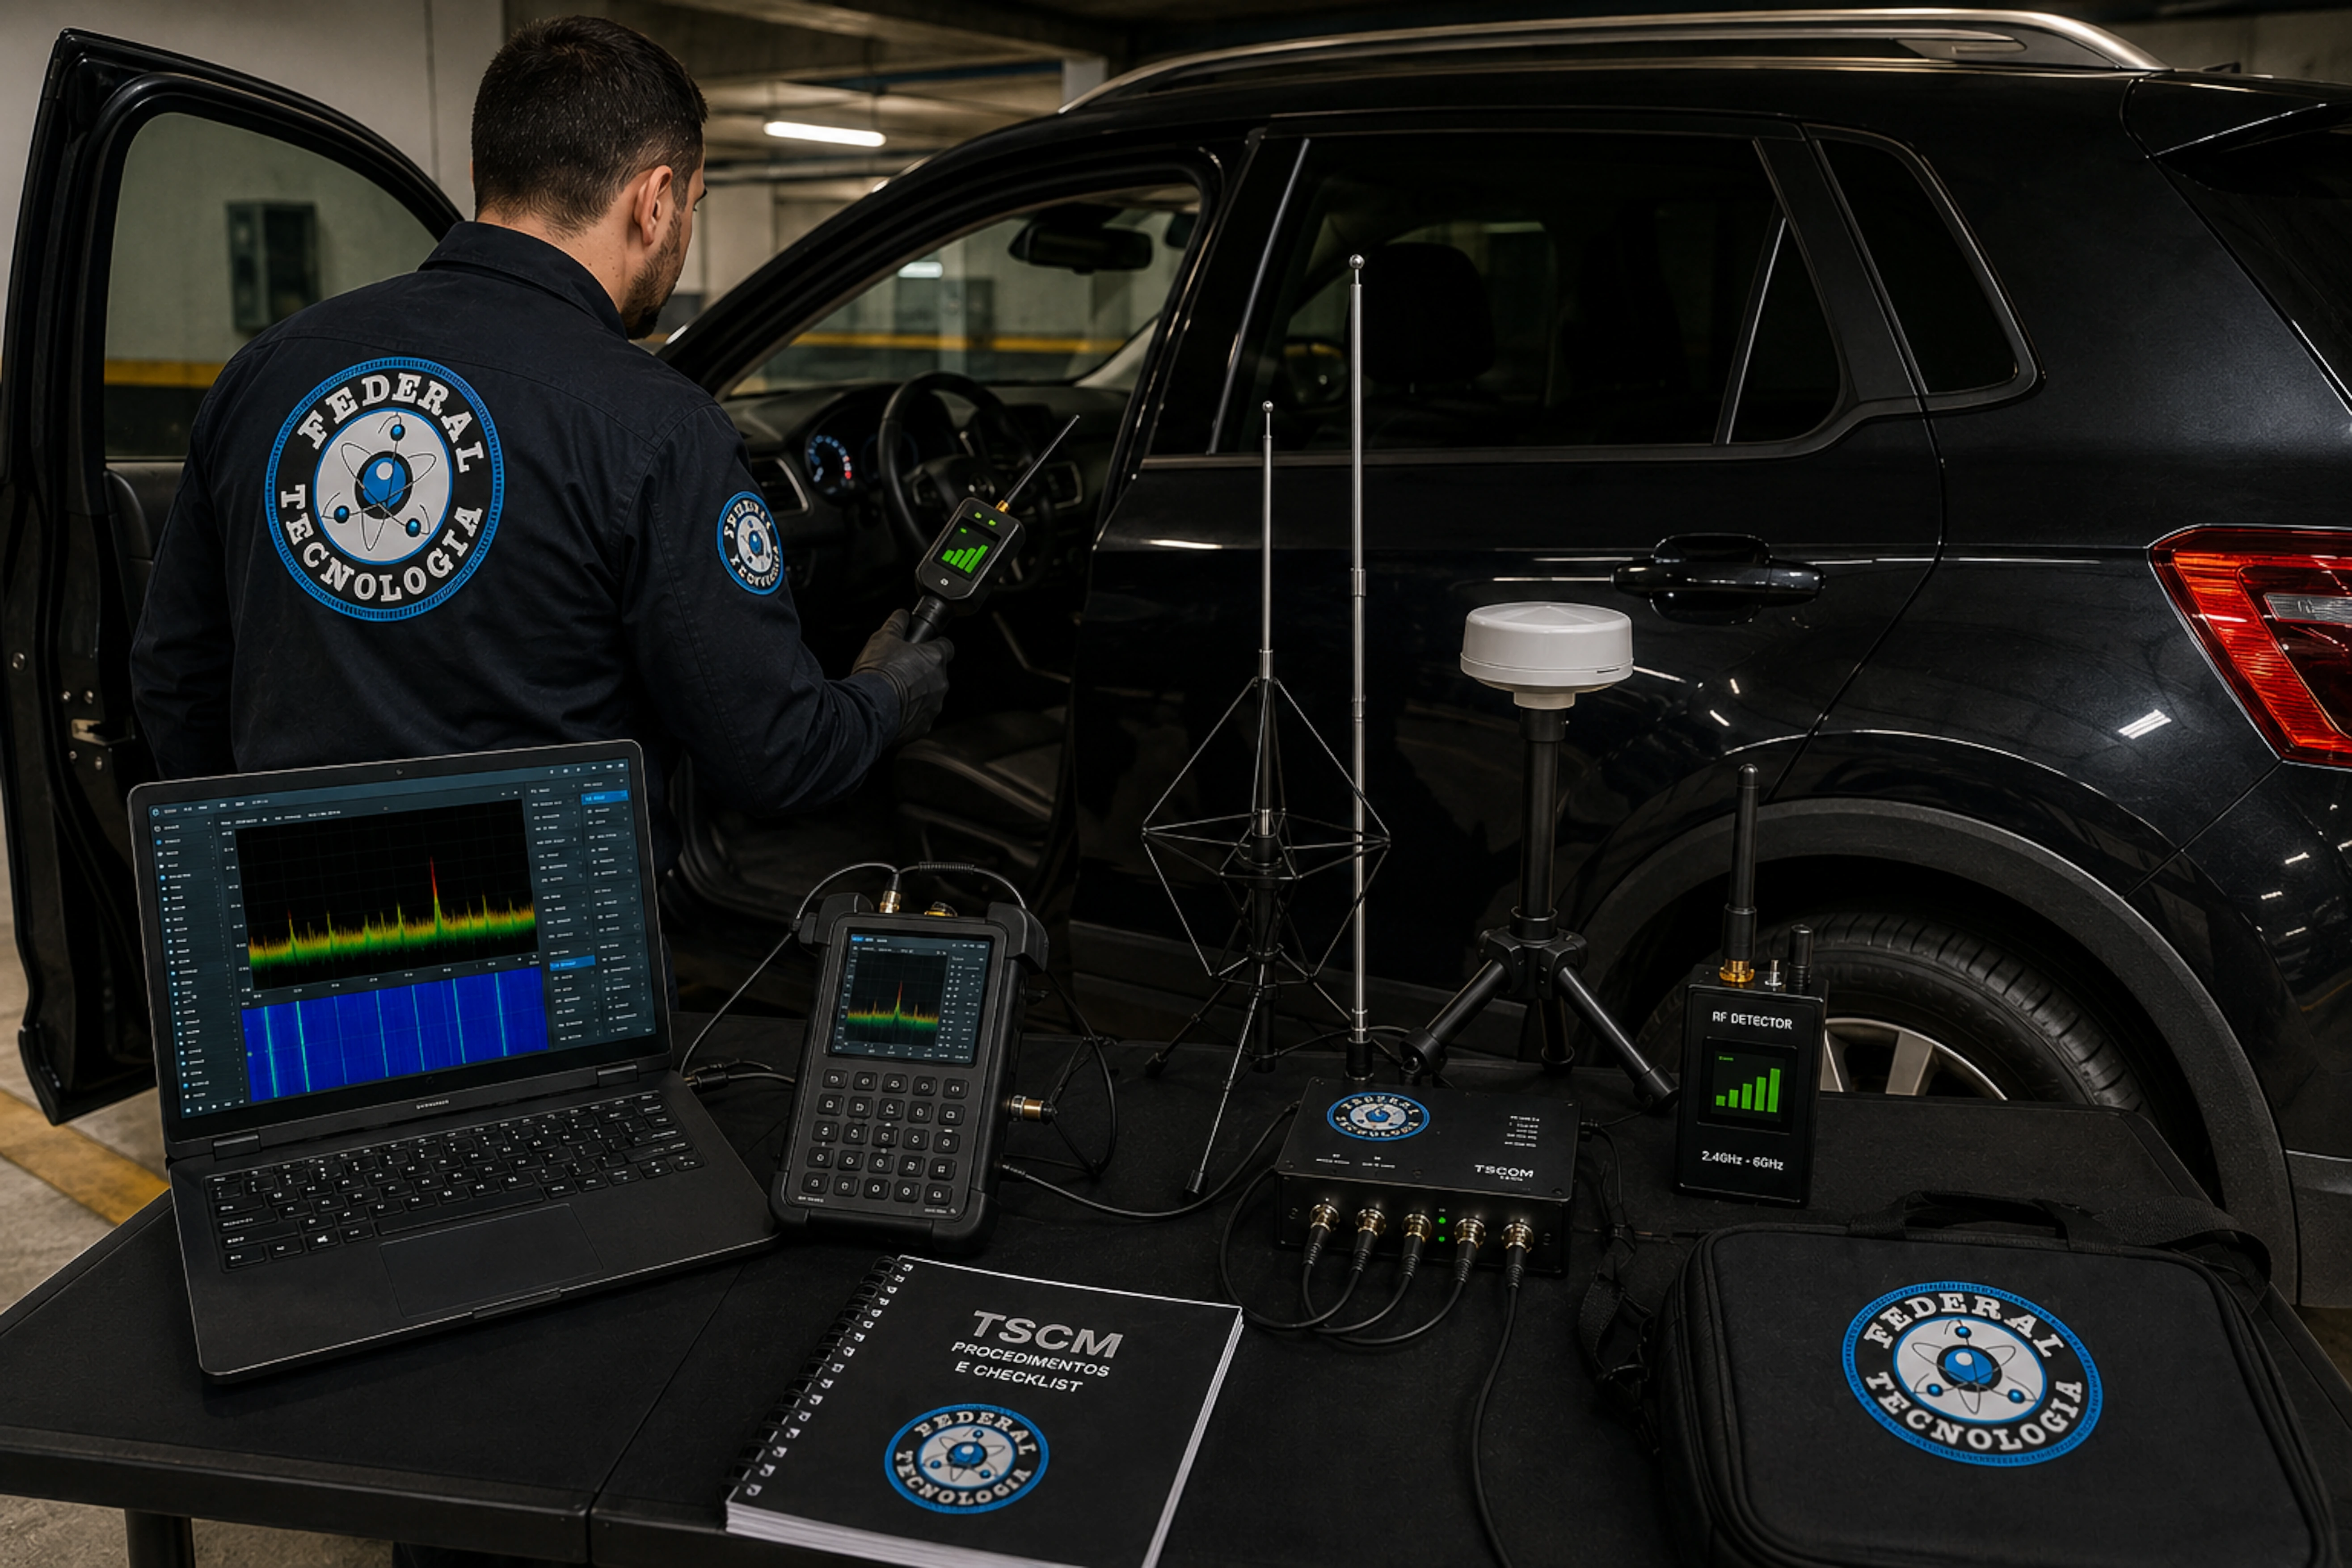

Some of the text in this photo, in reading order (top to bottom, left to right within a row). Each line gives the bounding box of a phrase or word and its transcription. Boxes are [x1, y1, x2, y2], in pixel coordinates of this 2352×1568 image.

[297, 372, 484, 473] FEDERAL
[281, 484, 483, 602] TECNOLOGIA
[1712, 1011, 1793, 1030] RF DETECTOR
[1752, 1156, 1783, 1171] 6GHz
[973, 1310, 1124, 1358] TSCM
[1863, 1293, 2064, 1358] FEDERAL
[951, 1341, 1110, 1378] PROCEDIMENTOS
[955, 1361, 1083, 1392] E CHECKLIST
[1866, 1371, 2082, 1451] TECNOLOGIA
